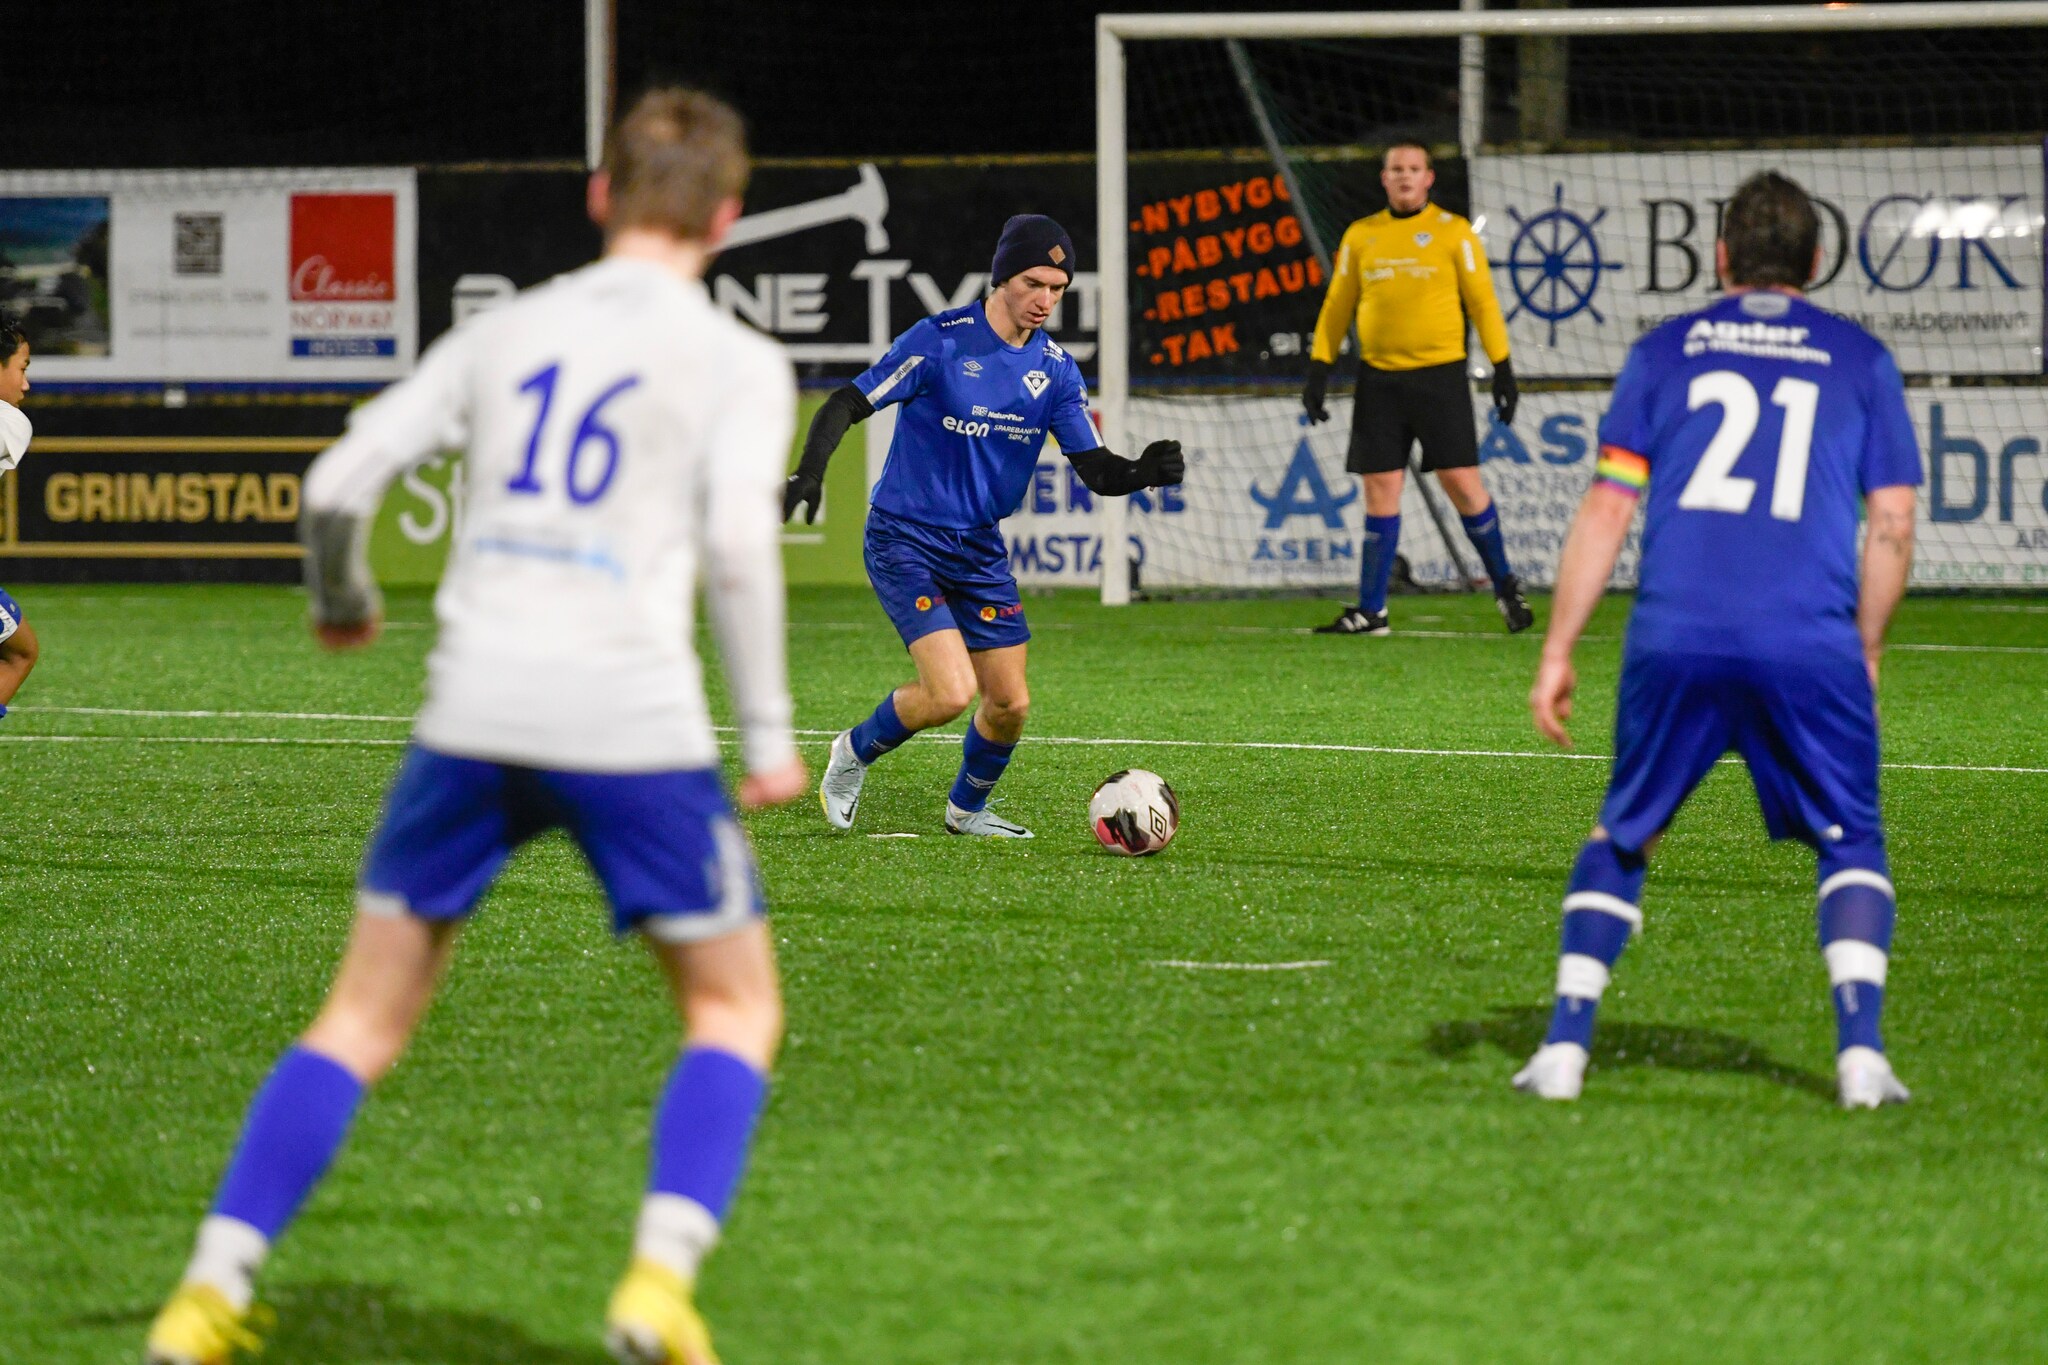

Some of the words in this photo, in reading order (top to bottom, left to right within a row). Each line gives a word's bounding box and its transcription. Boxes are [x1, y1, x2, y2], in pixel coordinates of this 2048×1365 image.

[44, 472, 300, 523] GRIMSTAD
[506, 363, 642, 505] 16
[1678, 370, 1820, 522] 21
